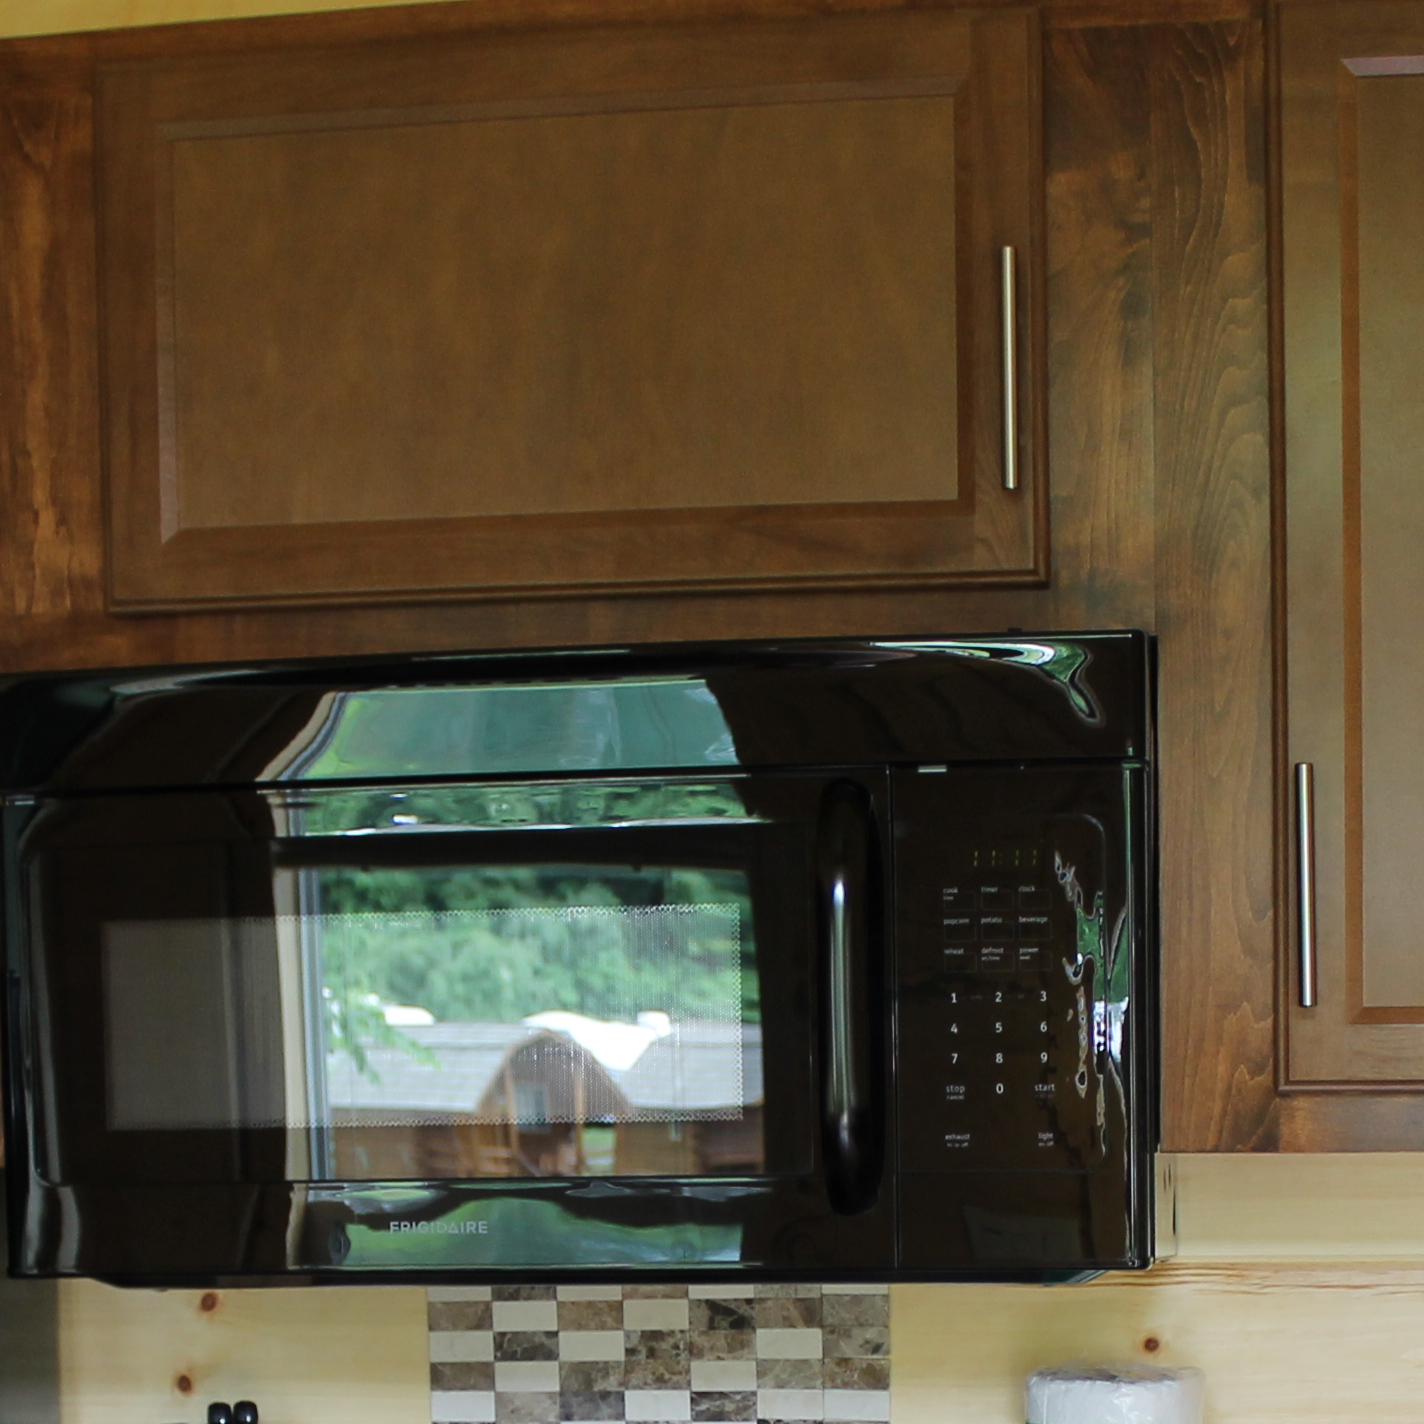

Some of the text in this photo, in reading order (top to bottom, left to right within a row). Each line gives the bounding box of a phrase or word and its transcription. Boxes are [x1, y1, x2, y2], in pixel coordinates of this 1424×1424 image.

[950, 992, 958, 1003] 1
[995, 991, 1002, 1003] 2
[1040, 990, 1047, 1002] 3
[950, 1023, 958, 1034] 4
[995, 1022, 1003, 1033] 5
[1040, 1021, 1048, 1032] 6
[951, 1053, 958, 1064] 7
[995, 1052, 1003, 1064] 8
[1040, 1052, 1048, 1063] 9
[946, 1085, 965, 1093] stop
[996, 1083, 1004, 1094] 0
[1034, 1083, 1055, 1092] start
[389, 1221, 488, 1234] FRIGIDAIRE
